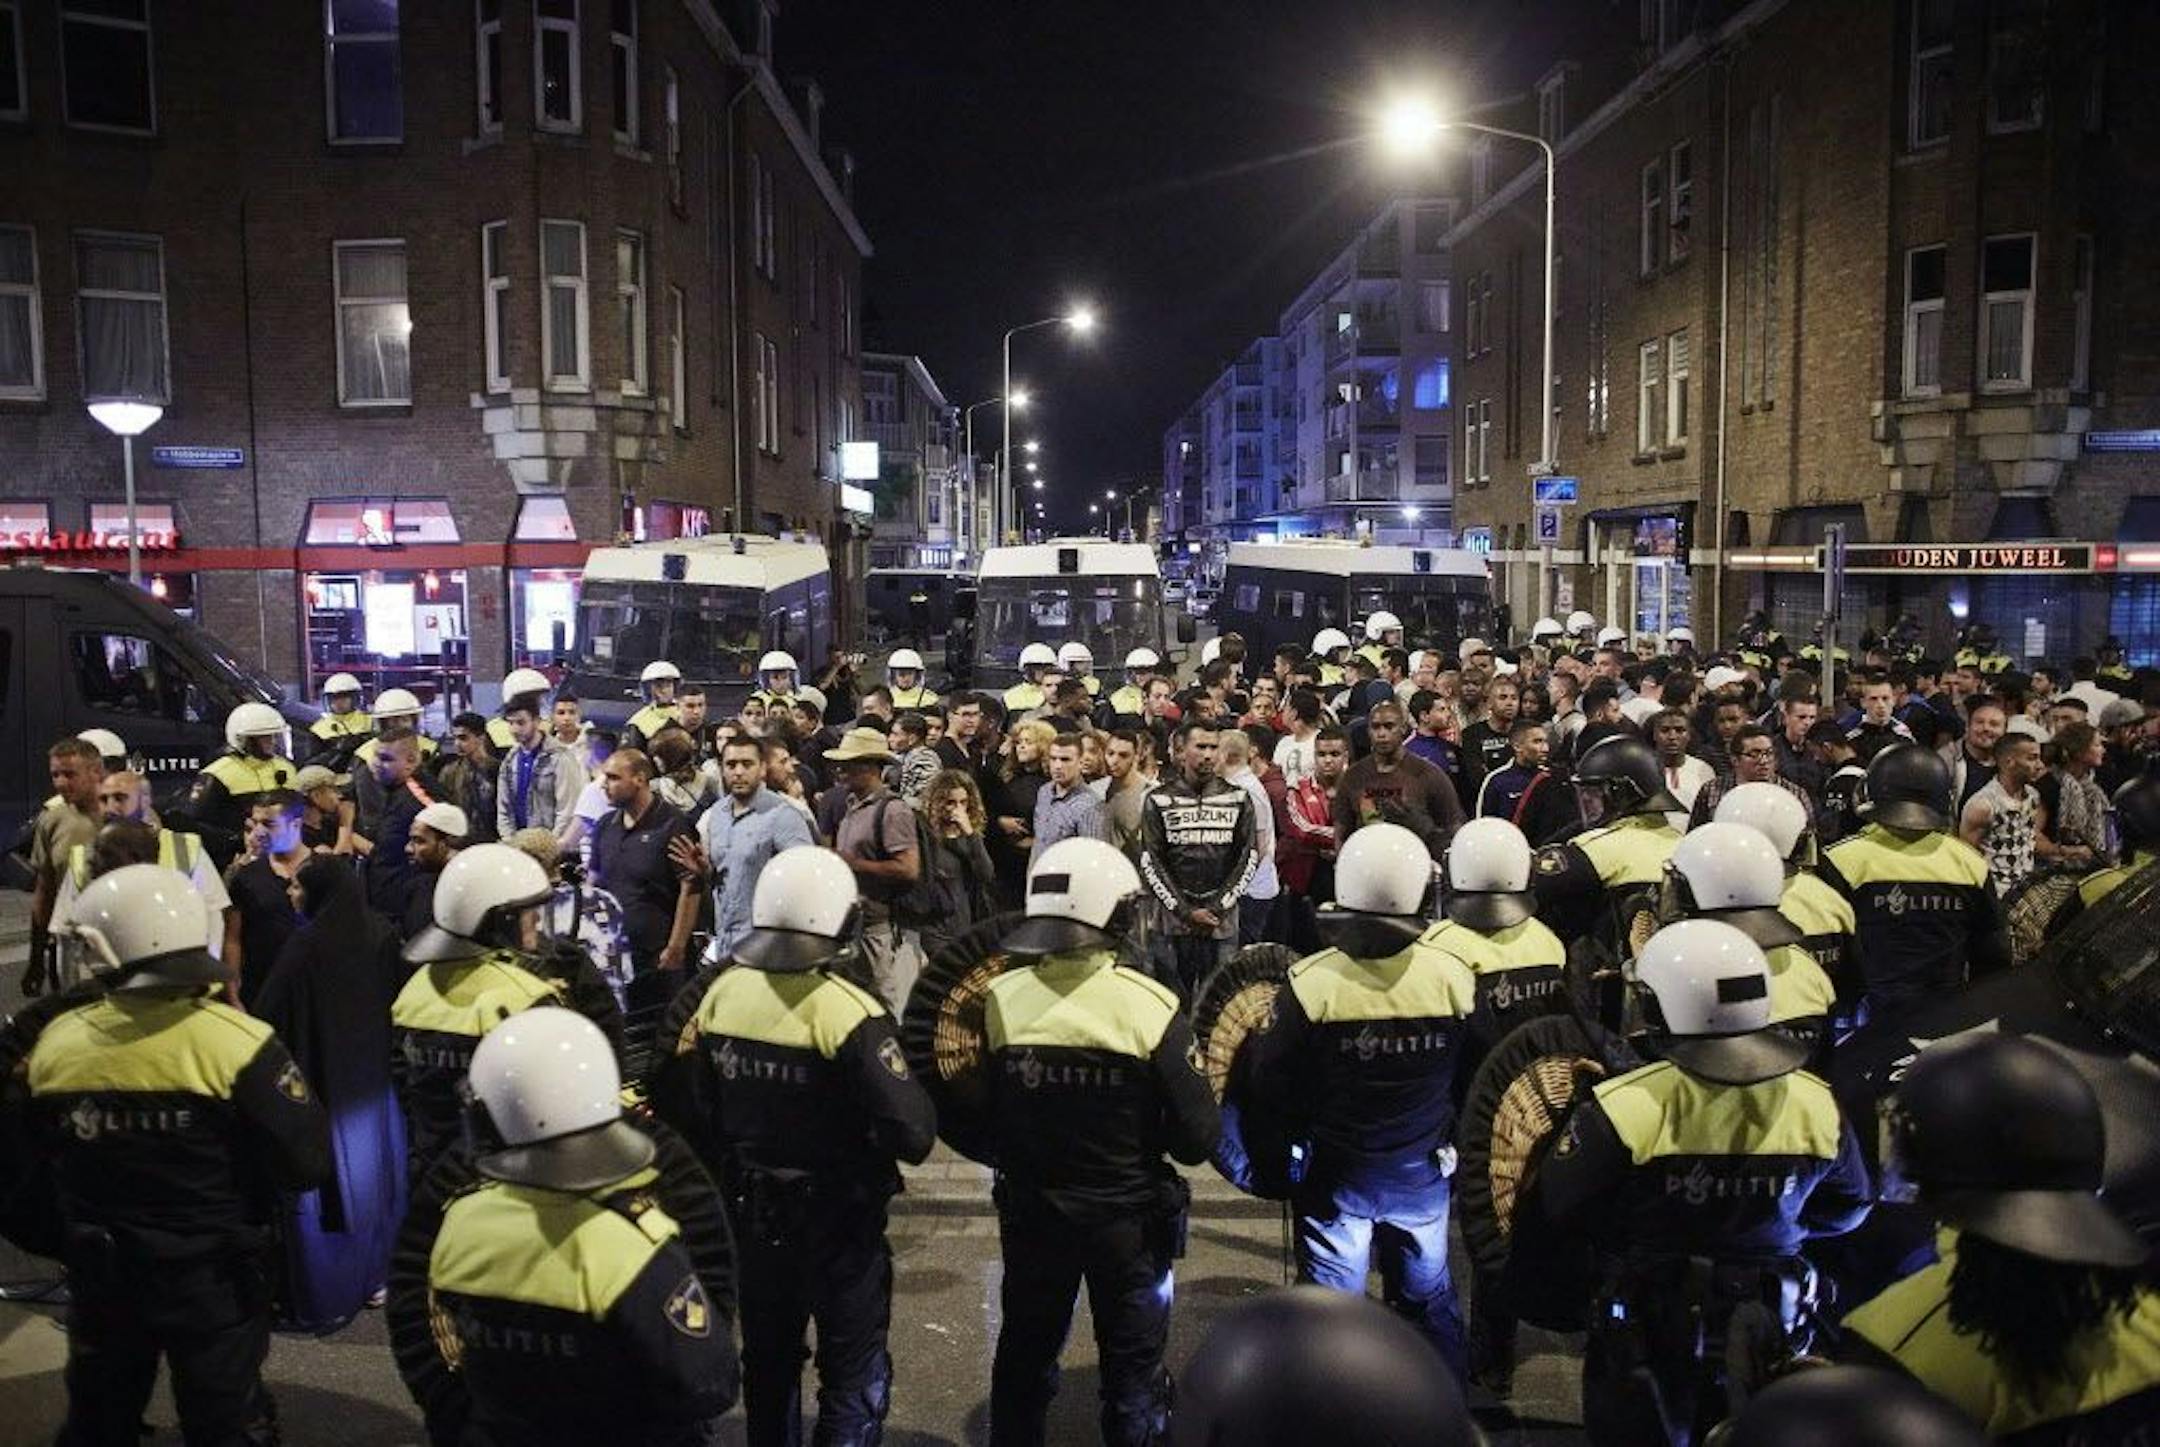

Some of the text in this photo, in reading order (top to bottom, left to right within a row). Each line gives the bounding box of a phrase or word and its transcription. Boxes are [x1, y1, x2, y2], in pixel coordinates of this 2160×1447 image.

[1967, 549, 2067, 568] JUWEEL
[1182, 810, 1233, 824] SUZUKI
[1874, 885, 1966, 914] POLITIE
[1341, 1027, 1449, 1061] POLITIE
[711, 1041, 810, 1083] POLITIE
[1006, 1049, 1125, 1088] POLITIE
[1665, 1162, 1798, 1204] POLITIE
